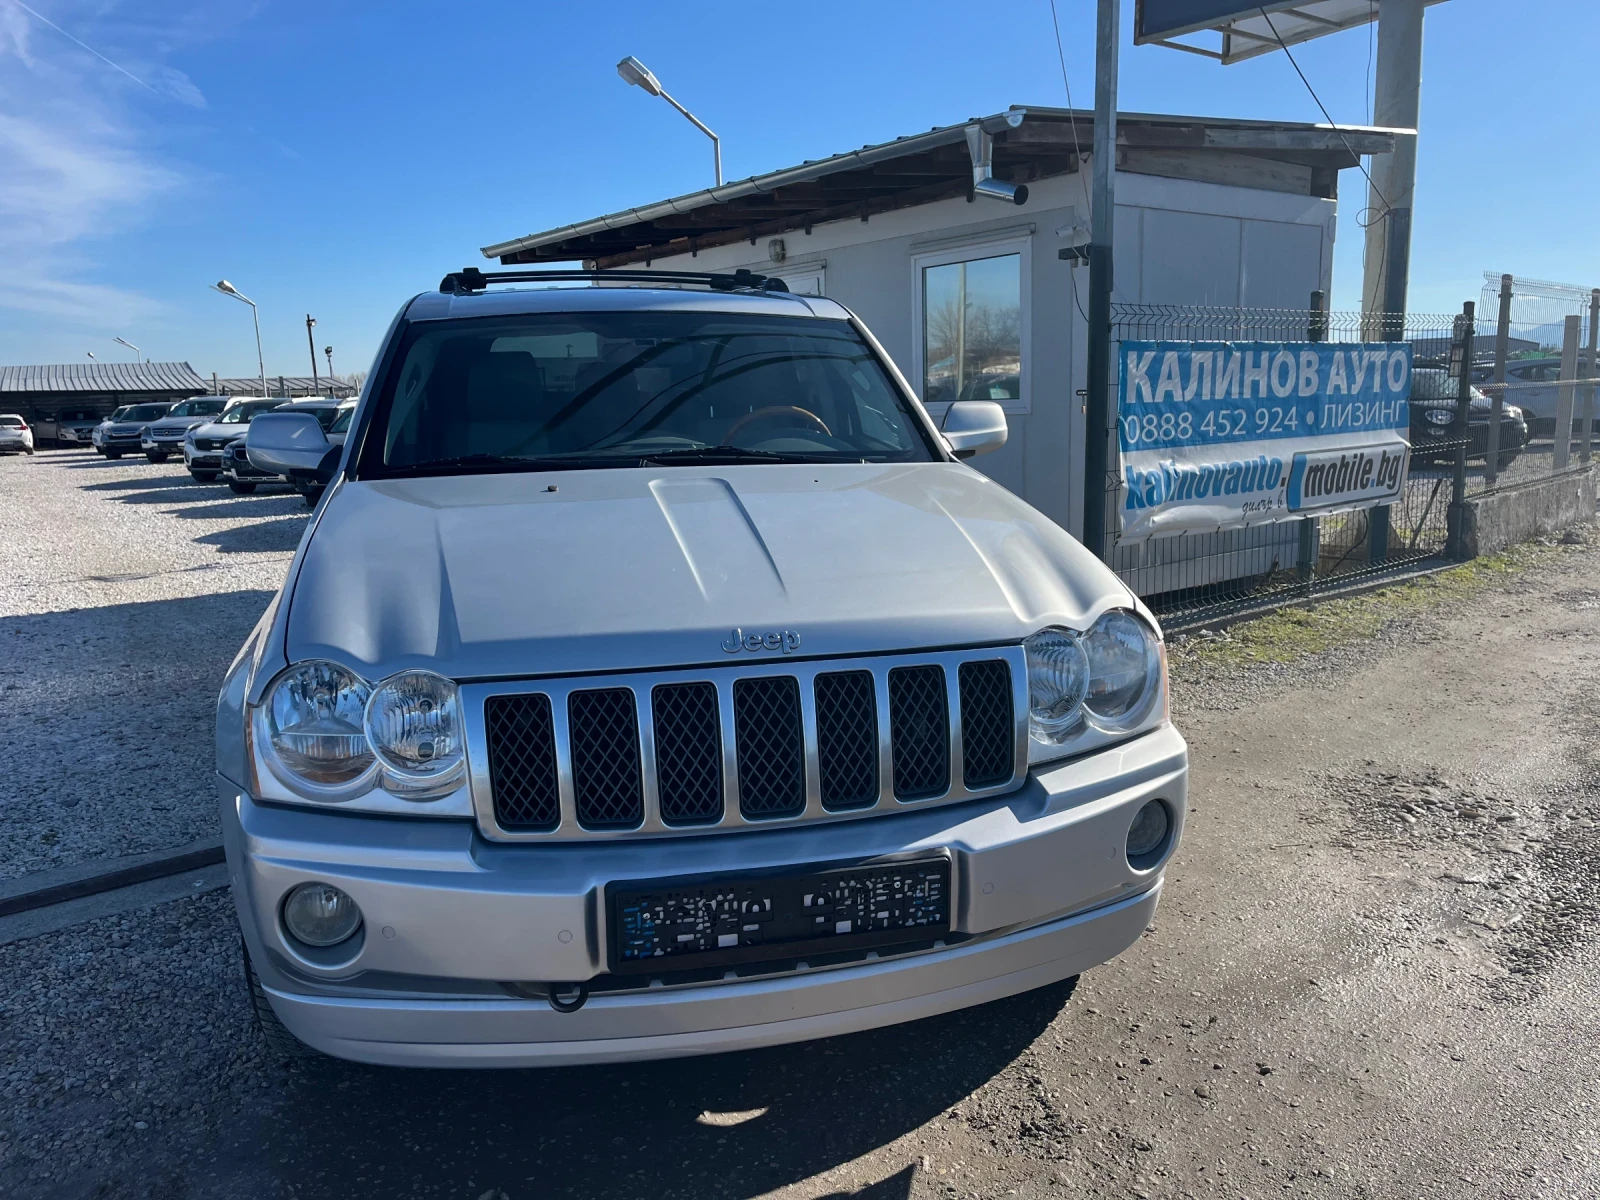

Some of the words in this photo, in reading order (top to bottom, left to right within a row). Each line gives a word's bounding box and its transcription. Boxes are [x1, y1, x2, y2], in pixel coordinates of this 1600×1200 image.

[1126, 350, 1320, 404] КАЛИНОВ
[1326, 349, 1408, 395] АУТО
[1125, 411, 1193, 444] 0888
[1200, 408, 1247, 437] 452
[1255, 406, 1299, 433] 924
[1320, 399, 1406, 429] ЛИЗИНГ
[1304, 450, 1402, 498] mobile.bg
[721, 627, 801, 654] Jeep
